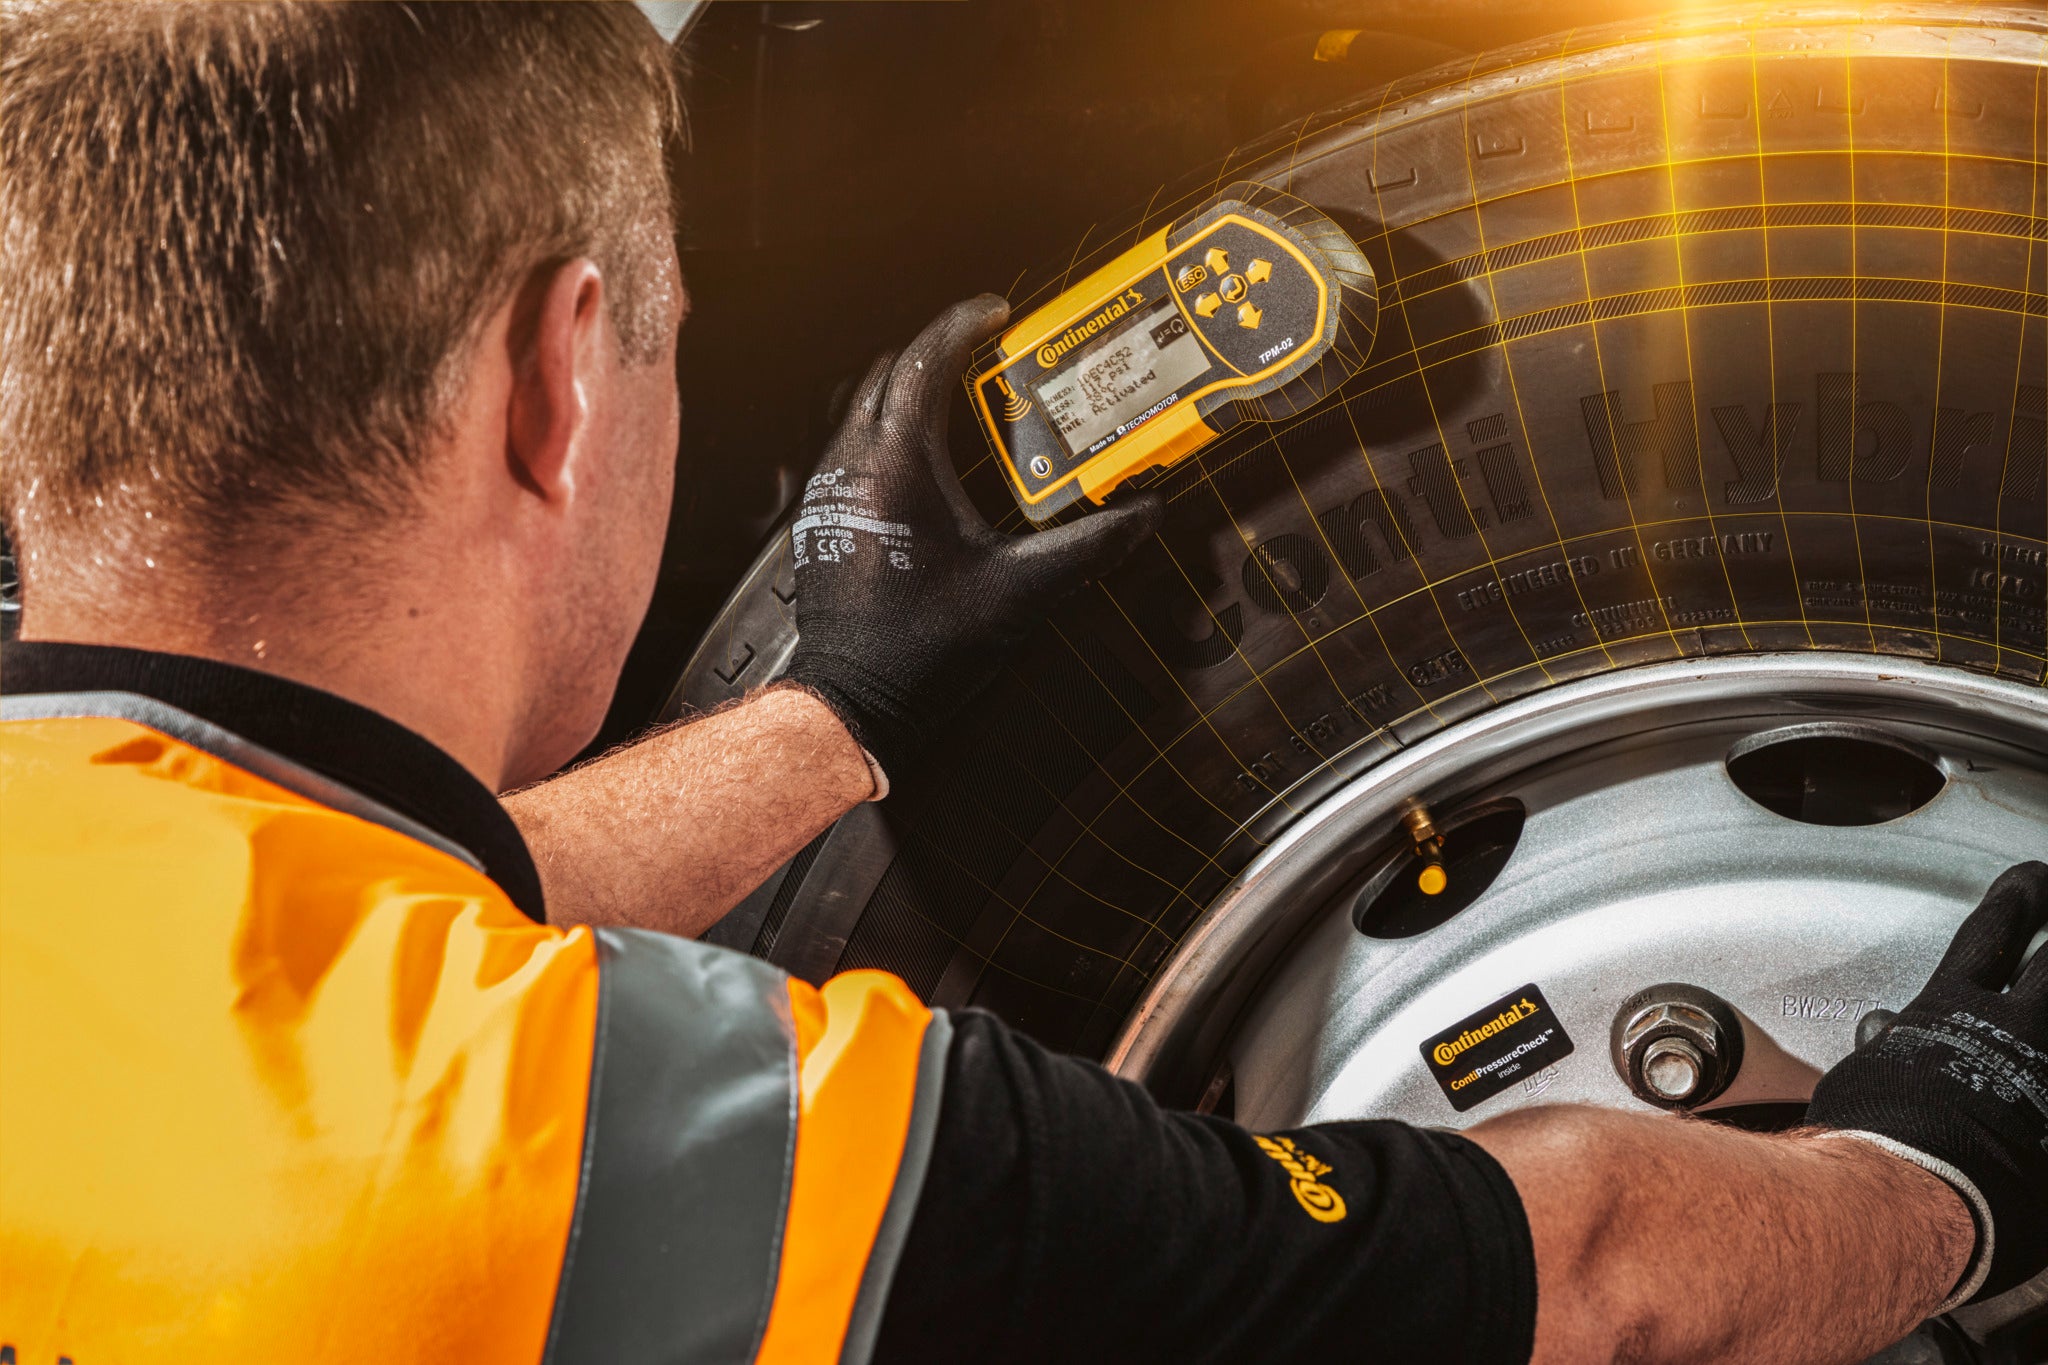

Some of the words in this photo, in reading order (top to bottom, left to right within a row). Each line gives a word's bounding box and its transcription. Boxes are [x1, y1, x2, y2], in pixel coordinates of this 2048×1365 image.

[1181, 269, 1203, 289] ESC
[1036, 295, 1131, 369] Continental
[1259, 337, 1294, 364] TPM-02
[1091, 369, 1157, 416] Activated
[1109, 361, 1131, 381] psi
[1089, 440, 1107, 453] Made
[1106, 433, 1116, 443] by
[1125, 393, 1178, 431] TECNOMOTOR
[1137, 413, 1534, 670] Conti
[1457, 556, 1599, 611] ENGINEERED
[1610, 546, 1639, 569] IN
[1653, 532, 1773, 561] GERMANY
[1433, 1002, 1525, 1066] Continental
[1497, 1062, 1521, 1080] inside
